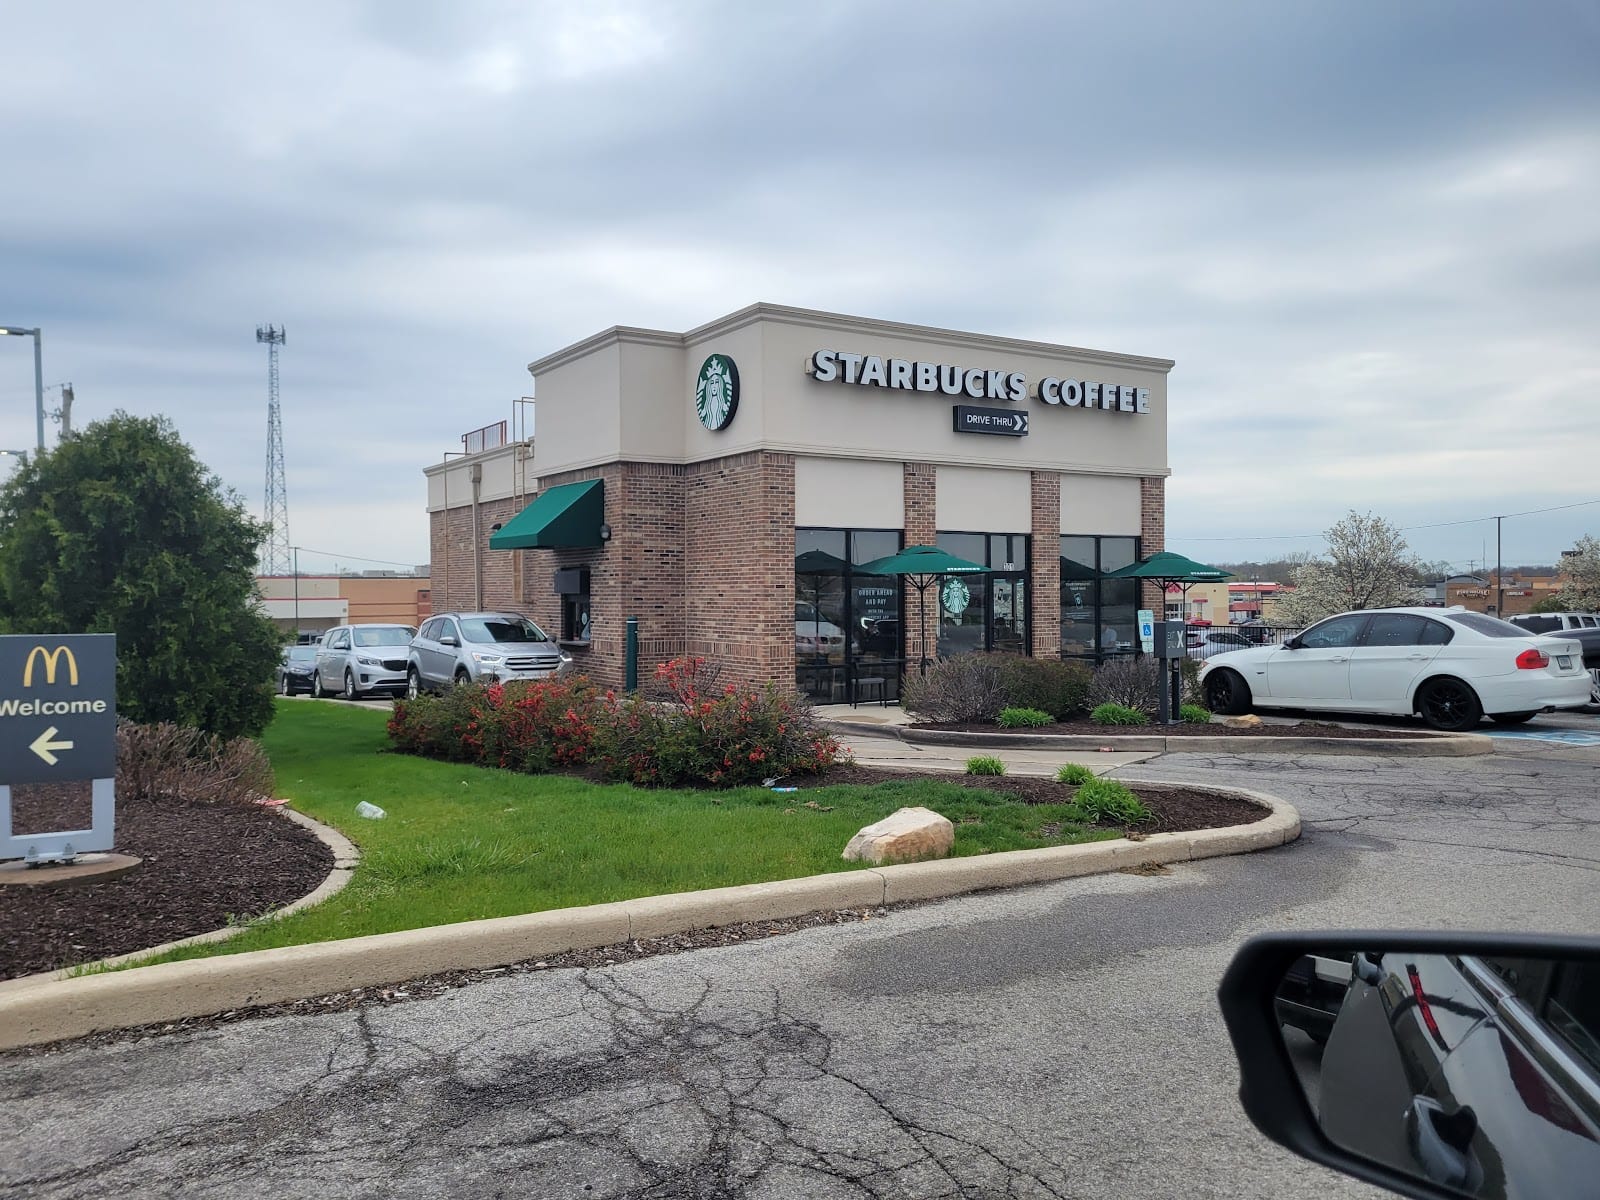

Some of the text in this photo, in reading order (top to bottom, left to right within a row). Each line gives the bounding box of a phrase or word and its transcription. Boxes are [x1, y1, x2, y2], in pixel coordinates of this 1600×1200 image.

[813, 349, 1151, 414] STARBUCKS COFFEE
[967, 414, 1013, 427] DRIVE THRU
[0, 698, 107, 717] Welcome
